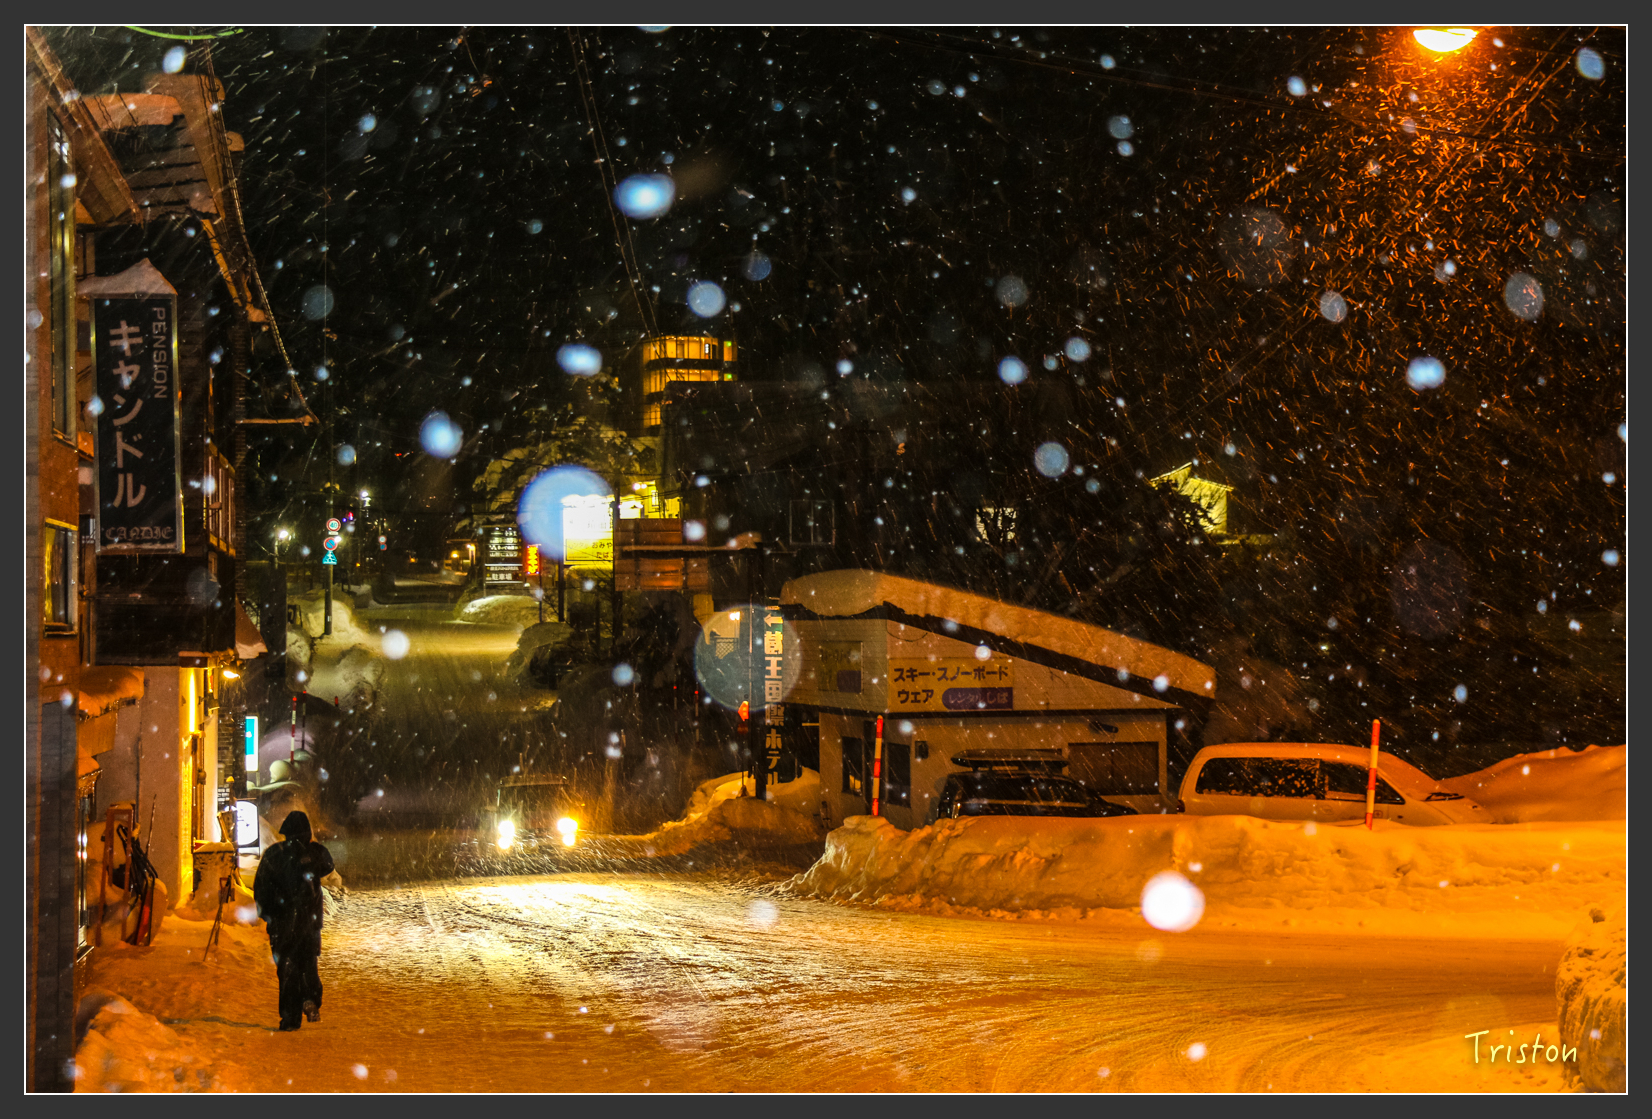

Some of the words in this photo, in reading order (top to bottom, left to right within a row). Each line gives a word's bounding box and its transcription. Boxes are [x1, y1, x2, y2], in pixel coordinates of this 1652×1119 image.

[152, 307, 168, 399] PENSION
[109, 320, 147, 508] キャンドル
[893, 666, 1009, 682] スキー・スノーボード
[897, 689, 934, 704] ウェア
